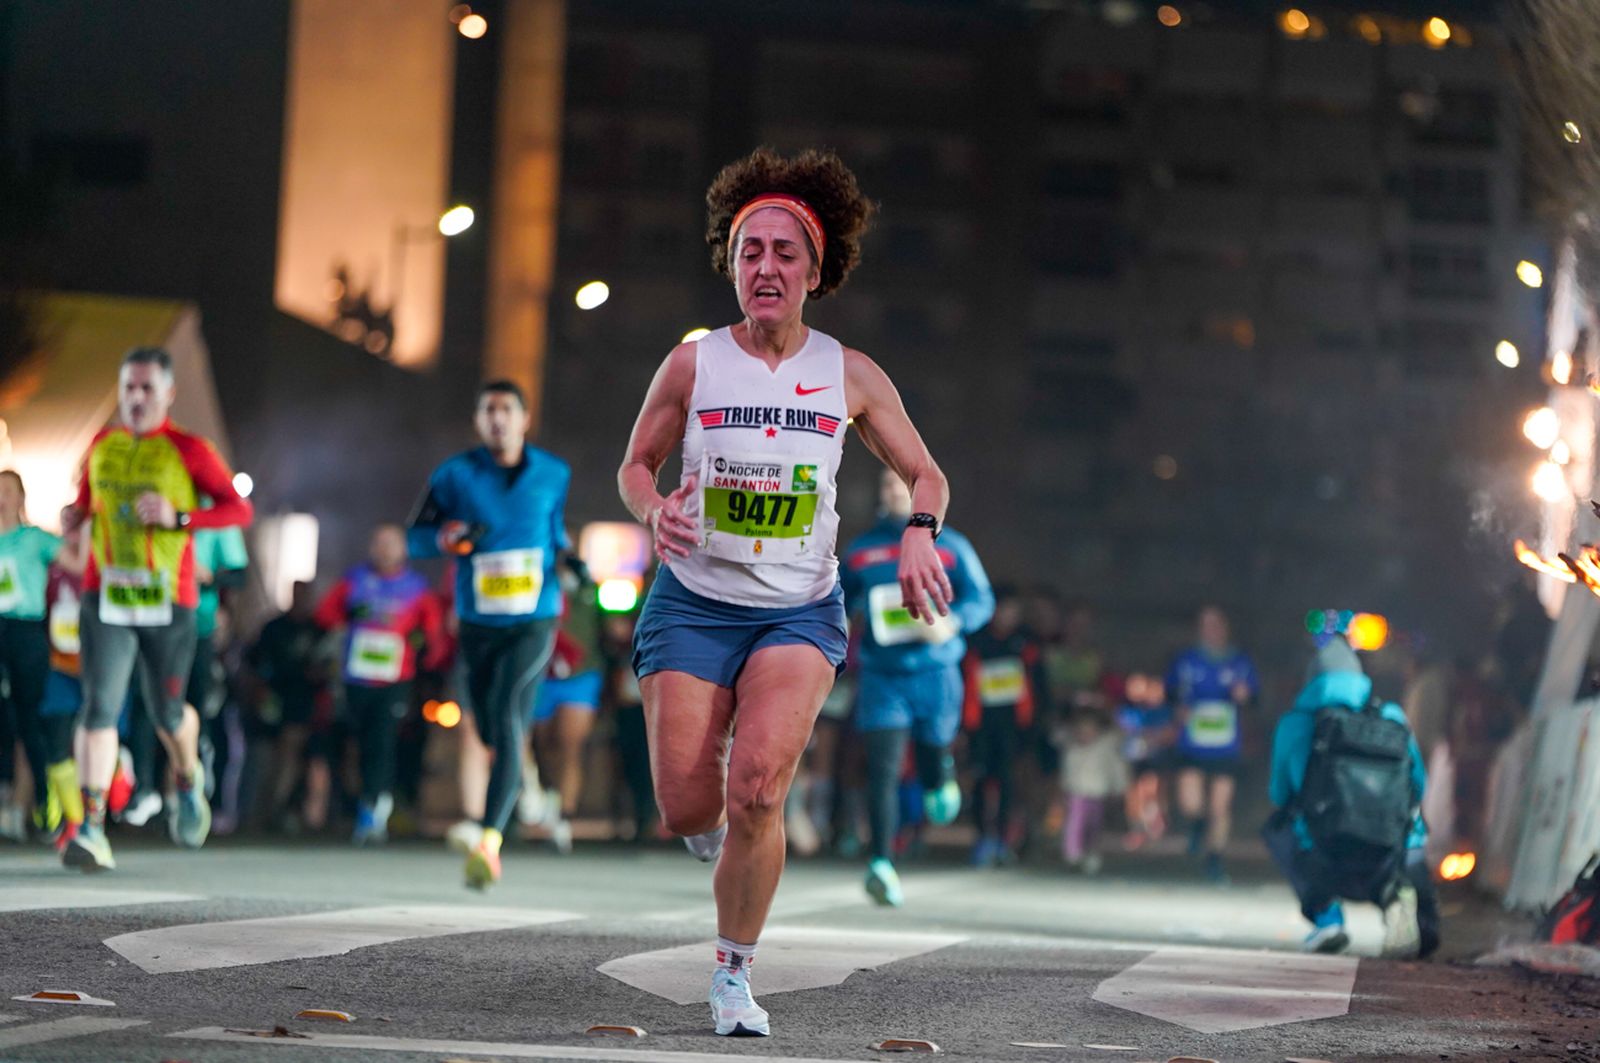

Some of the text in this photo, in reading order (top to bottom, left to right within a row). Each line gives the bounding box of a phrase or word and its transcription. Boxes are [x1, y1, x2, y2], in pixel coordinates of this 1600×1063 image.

[723, 407, 817, 428] TRUEKE RUN
[728, 466, 782, 478] NOCHE DE
[714, 476, 738, 489] SAN
[740, 478, 781, 492] ANTÓN
[728, 491, 798, 526] 9477
[745, 528, 772, 537] Paloma
